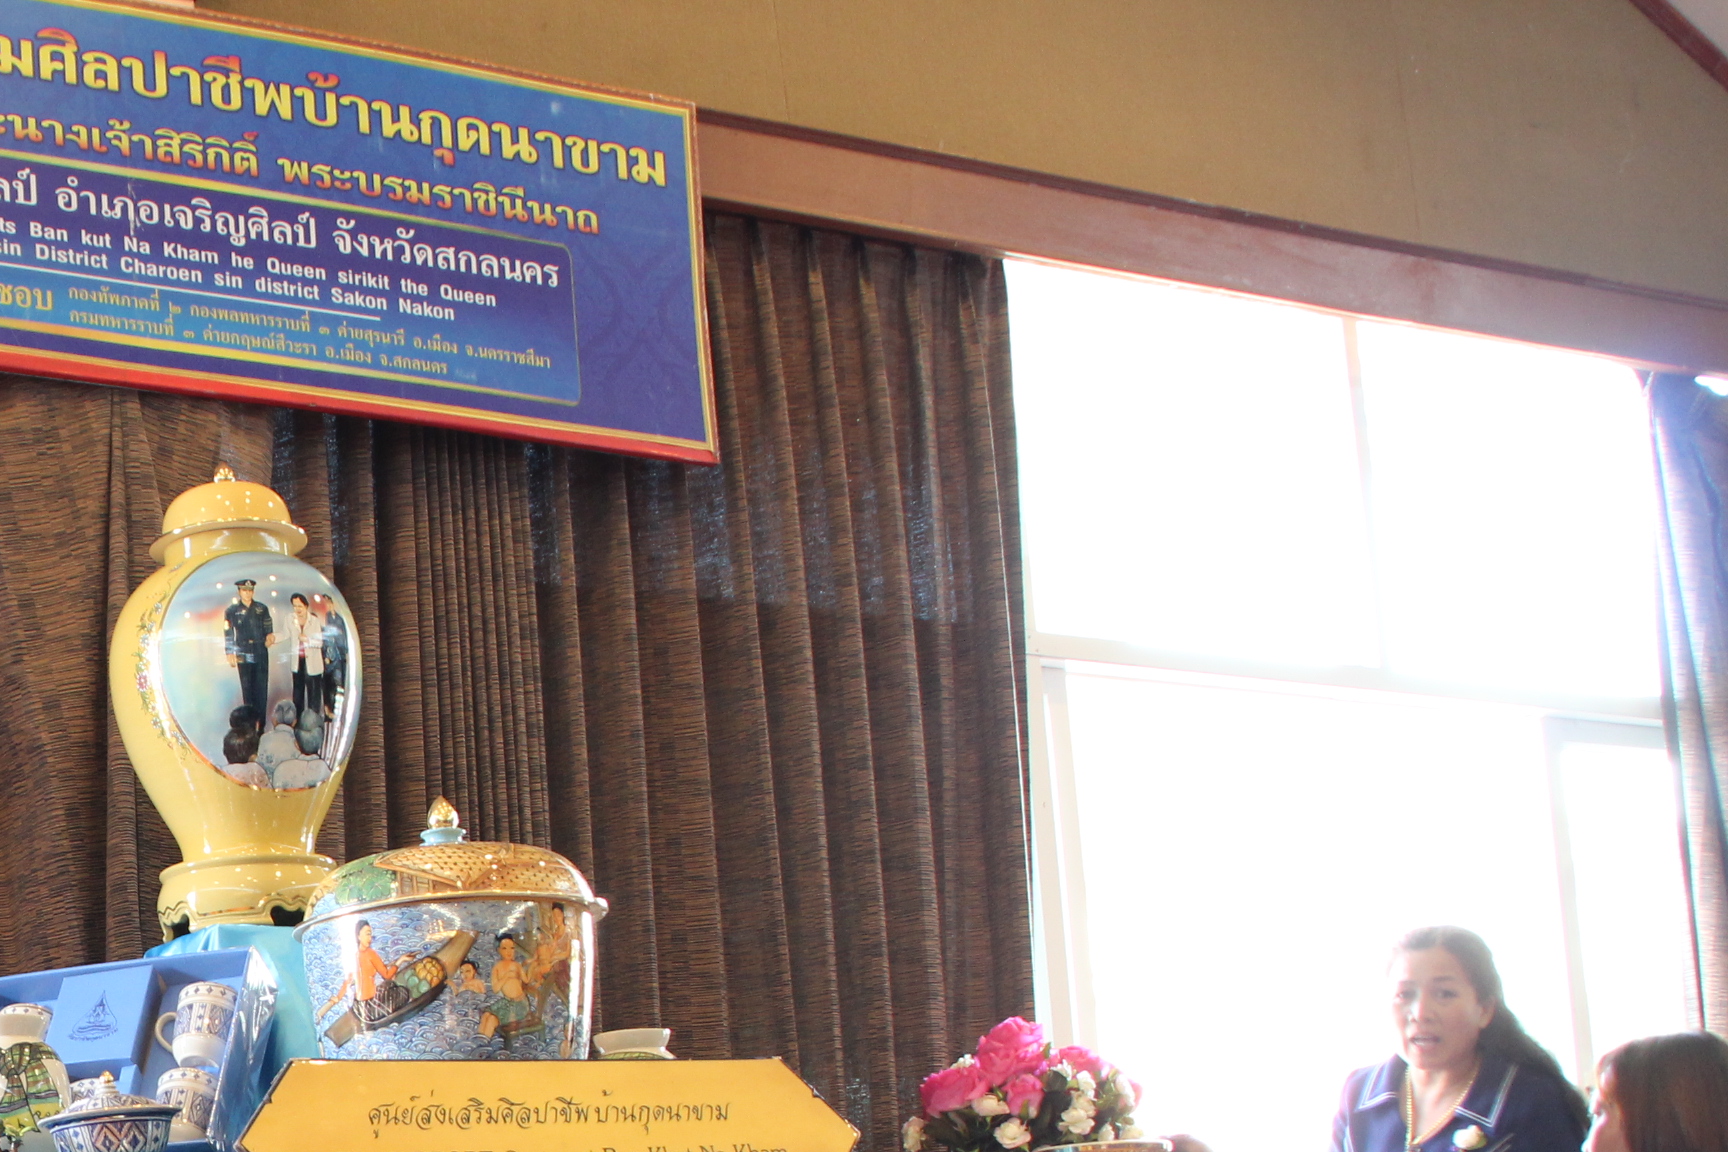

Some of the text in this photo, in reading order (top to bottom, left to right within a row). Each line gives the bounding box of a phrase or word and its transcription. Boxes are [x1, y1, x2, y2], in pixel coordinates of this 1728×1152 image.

[55, 175, 317, 249] อำเภอเจริญศิลป์
[333, 217, 560, 288] จังหวัดสกลนคร
[276, 152, 600, 235] พระบรมราชินีนาถ
[29, 221, 69, 243] Ban
[81, 229, 112, 249] kut
[124, 235, 151, 255] Na
[163, 241, 219, 267] Kham
[231, 252, 254, 270] he
[266, 257, 327, 281] Queen
[337, 268, 391, 289] sirikit
[400, 276, 429, 296] the
[439, 284, 497, 307] Queen
[35, 244, 108, 270] District
[119, 256, 203, 284] Charoen
[214, 270, 243, 290] sin
[255, 275, 320, 301] district
[331, 286, 388, 310] Sakon
[398, 293, 455, 321] Nakon
